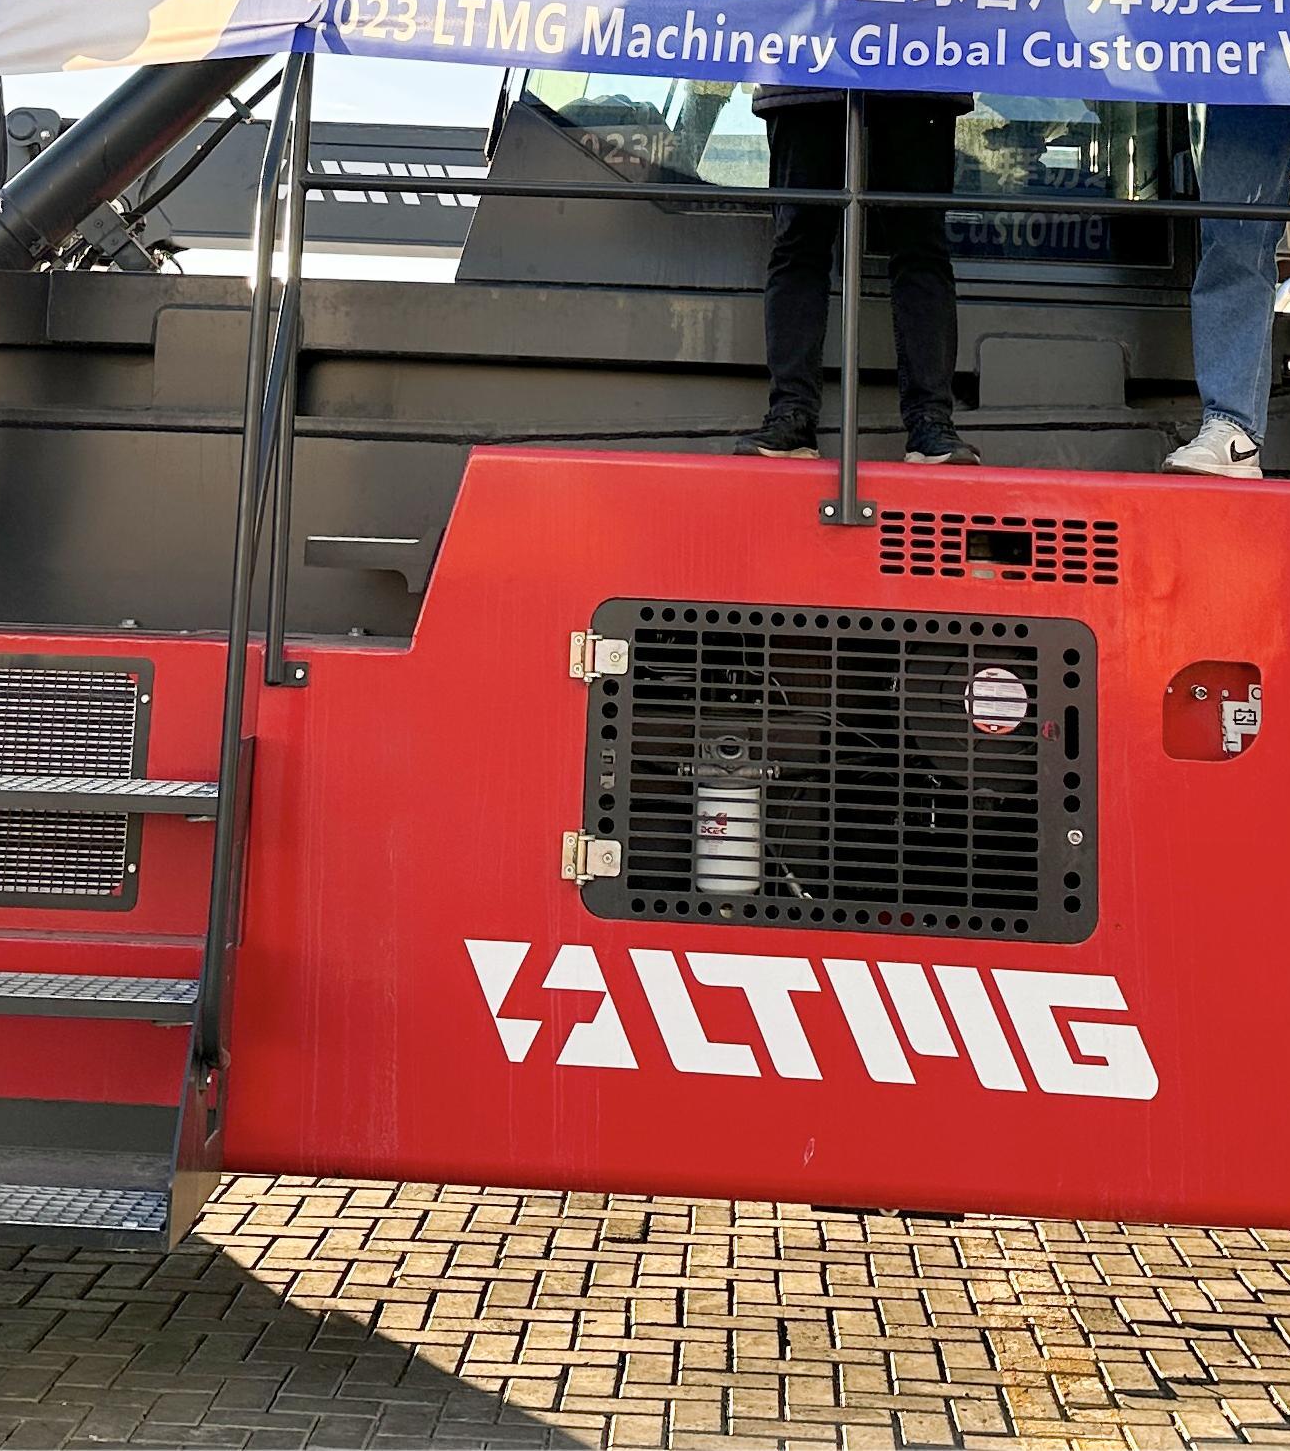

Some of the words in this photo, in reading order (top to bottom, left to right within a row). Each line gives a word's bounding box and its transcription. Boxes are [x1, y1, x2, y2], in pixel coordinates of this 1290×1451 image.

[579, 5, 837, 75] Machinery
[849, 23, 1007, 67] Global
[1021, 30, 1266, 77] Customer
[627, 947, 1160, 1102] LTMG
